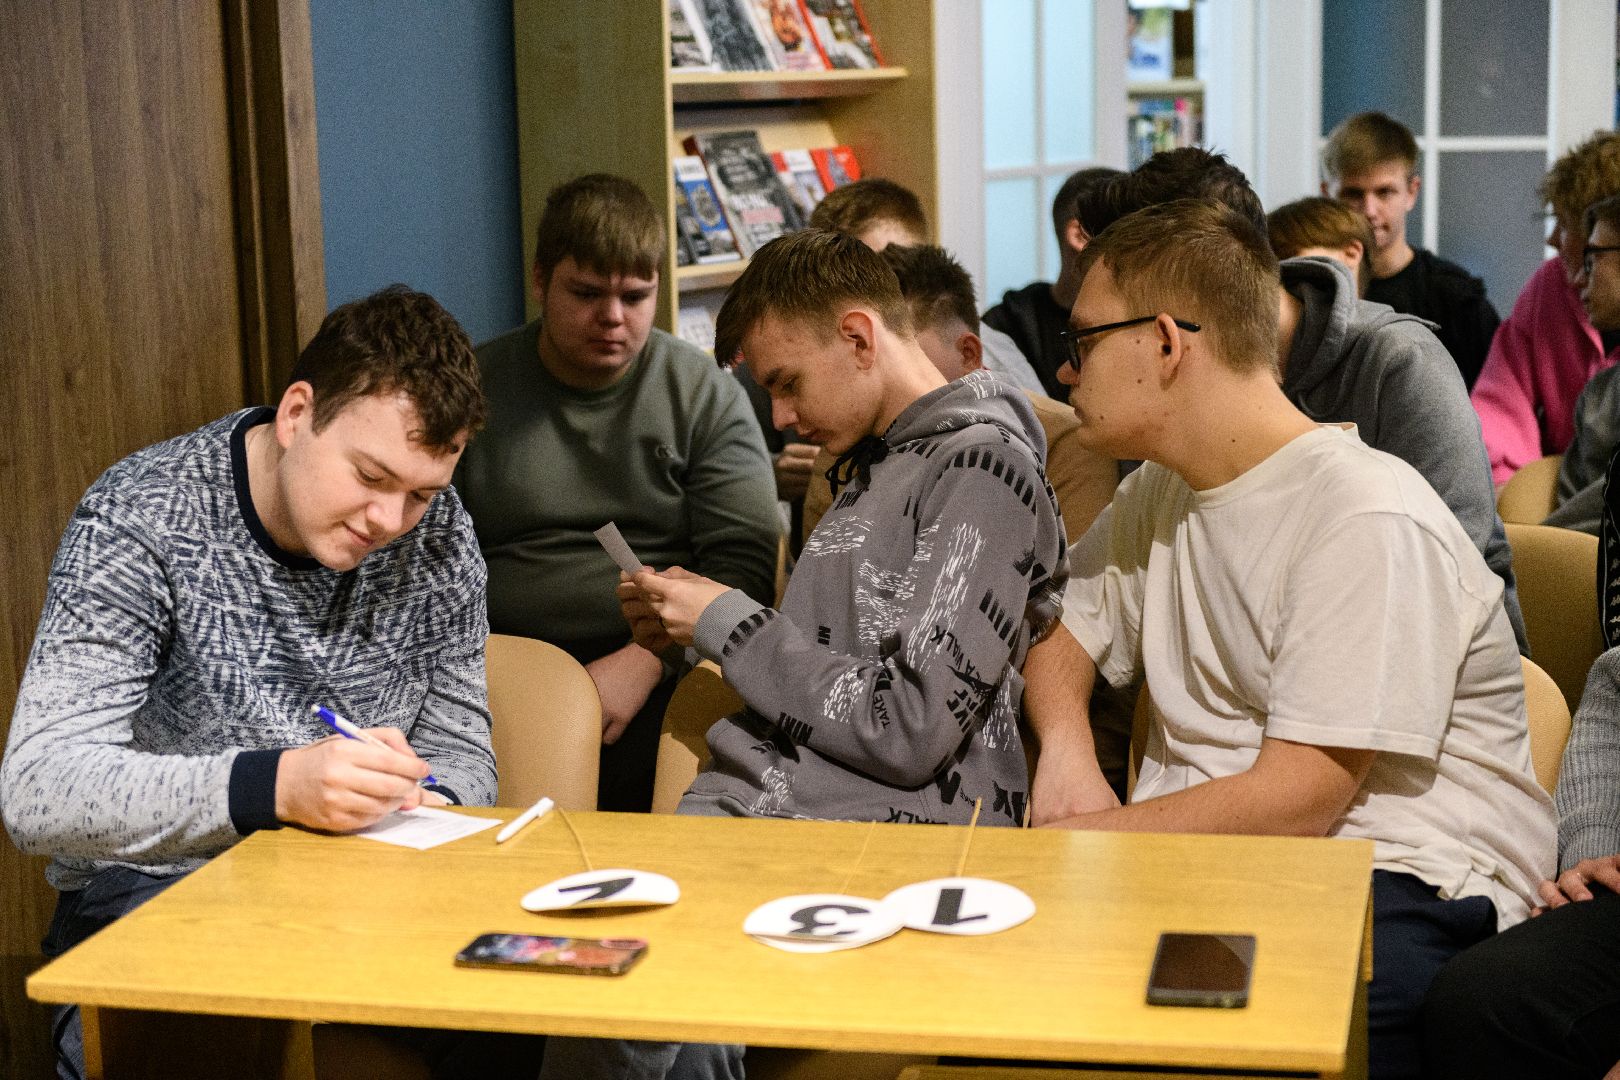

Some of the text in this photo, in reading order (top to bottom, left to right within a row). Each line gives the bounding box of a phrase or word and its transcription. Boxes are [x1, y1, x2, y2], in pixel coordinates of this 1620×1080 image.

[873, 694, 890, 729] TAKE
[787, 903, 871, 937] 3
[931, 887, 989, 927] 1
